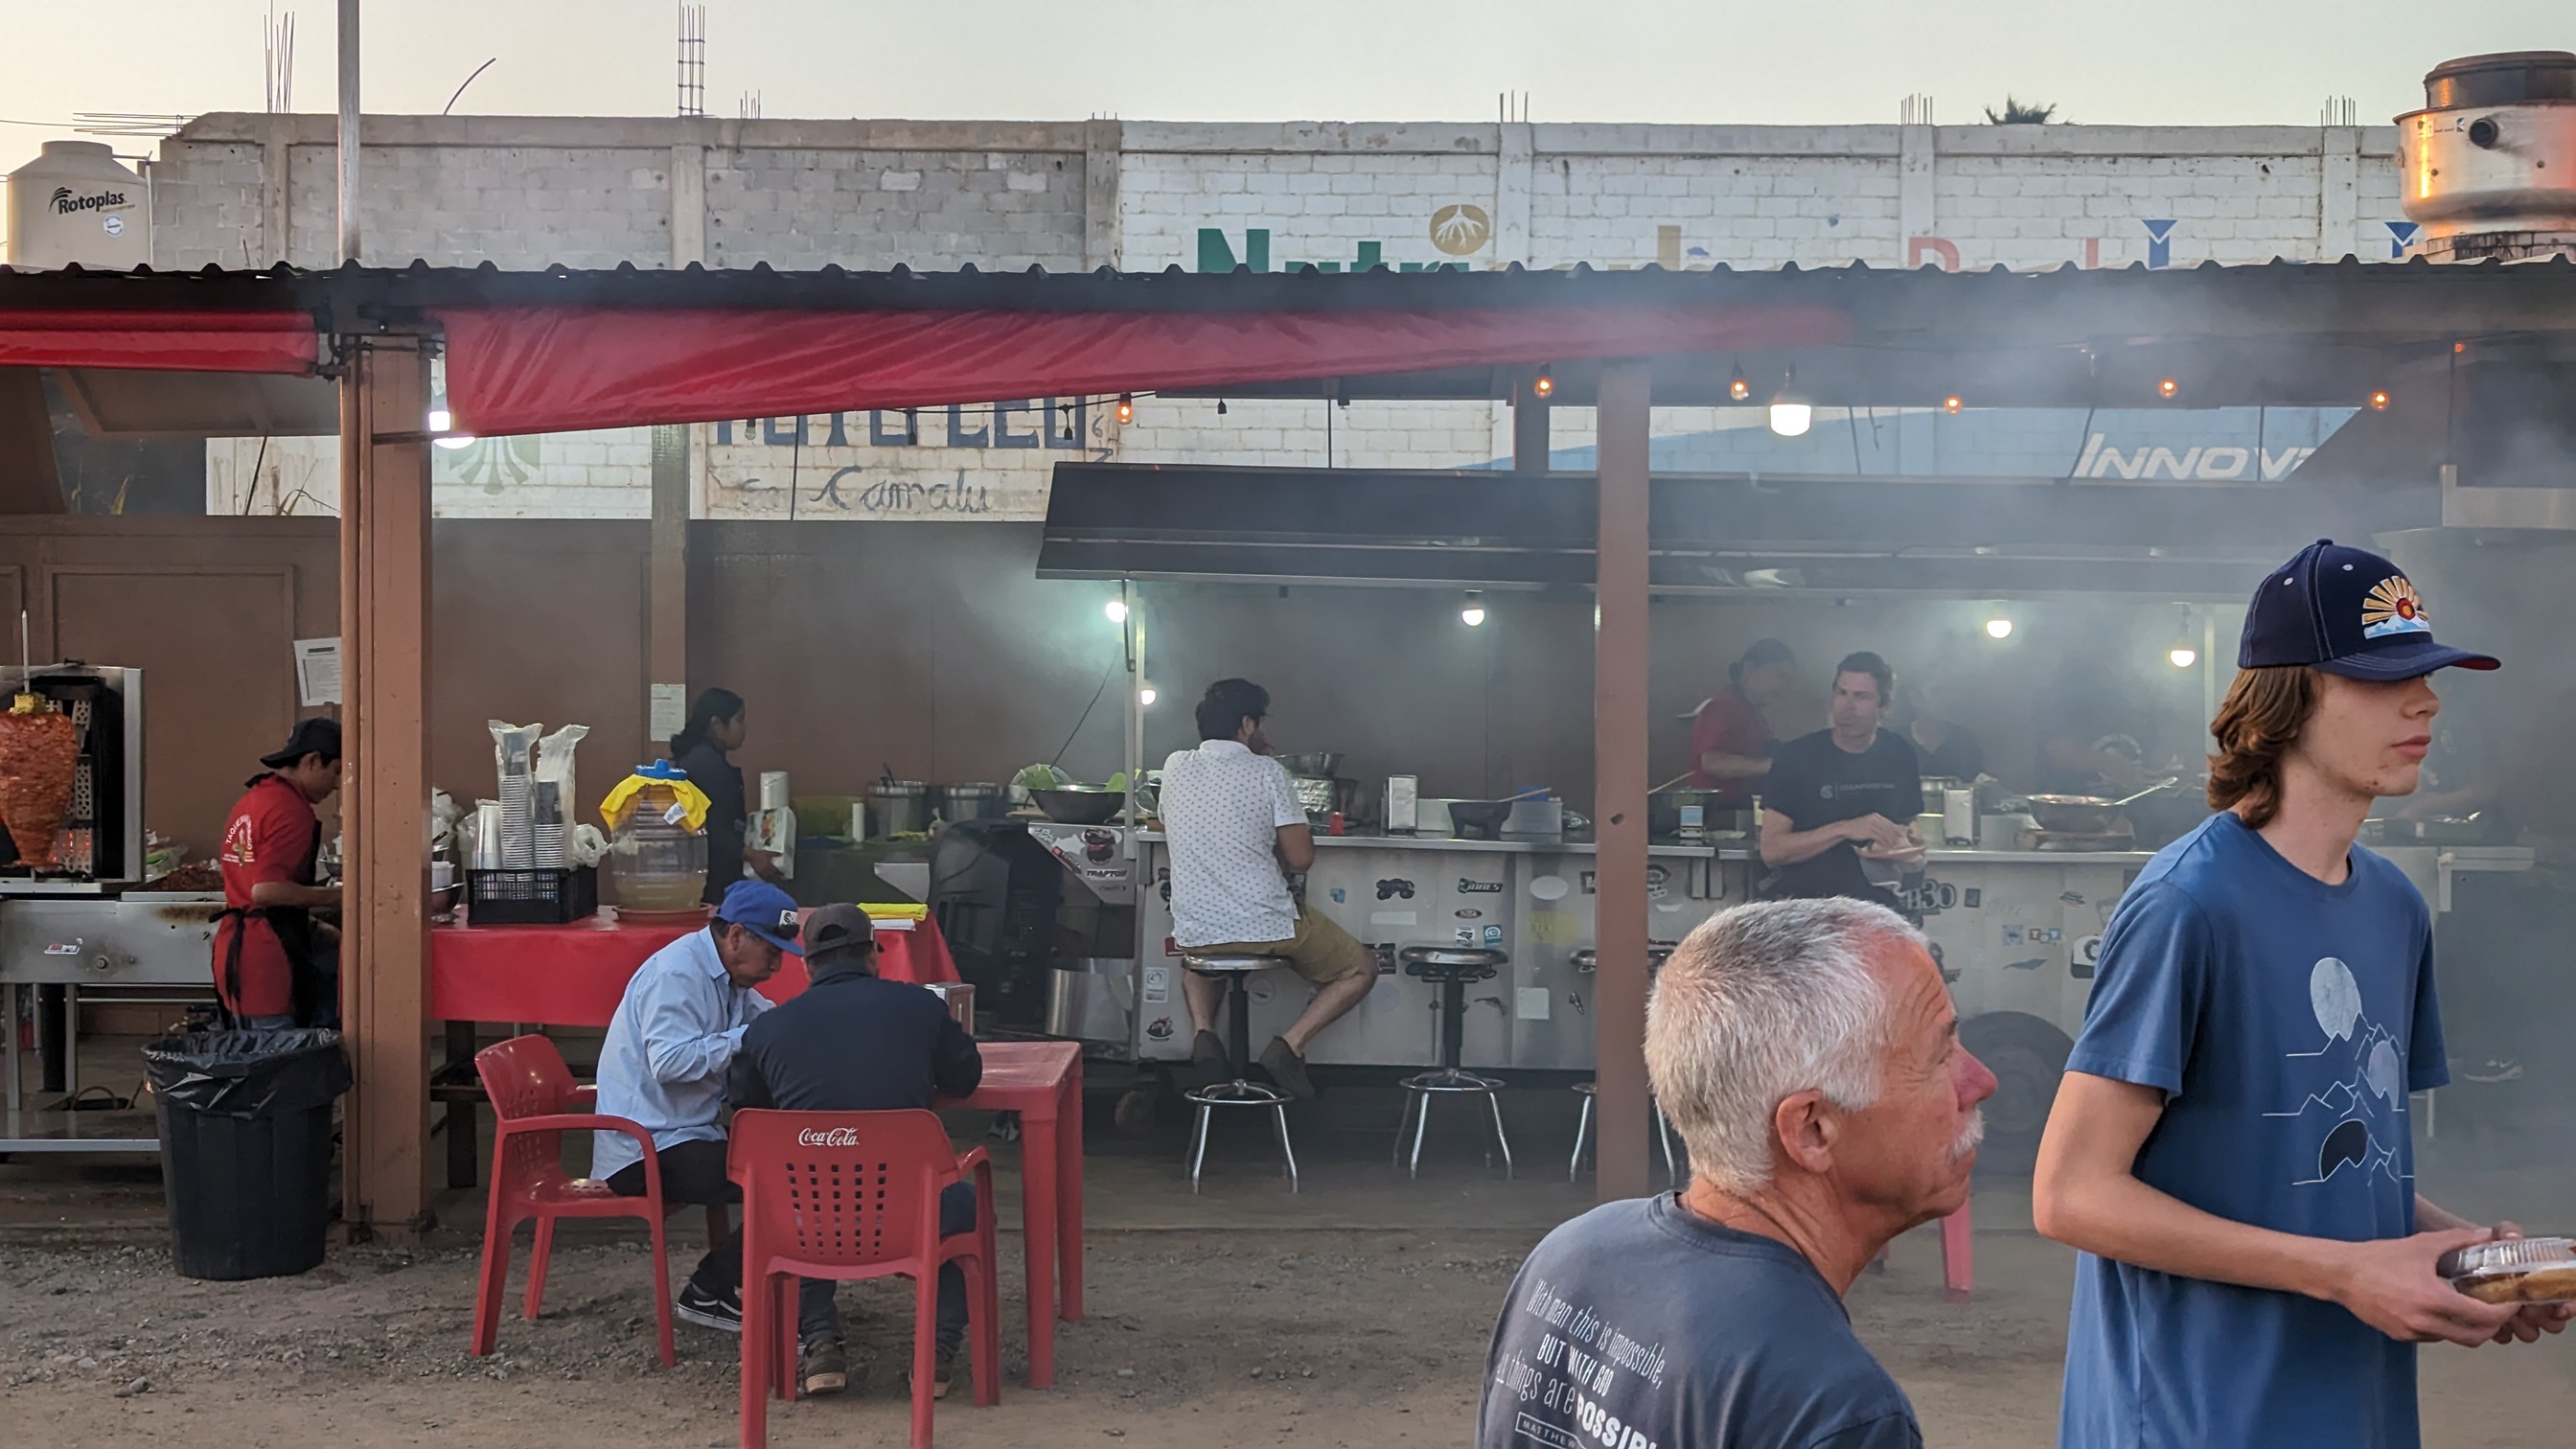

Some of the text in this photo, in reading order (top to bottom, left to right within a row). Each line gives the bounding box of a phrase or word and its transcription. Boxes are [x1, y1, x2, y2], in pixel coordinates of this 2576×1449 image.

[58, 190, 126, 215] Rotoplas
[798, 1127, 860, 1147] Coca-Cola
[1526, 1278, 1666, 1390] With man this is impossible,
[1536, 1333, 1615, 1398] BUT WITH GOD
[1506, 1348, 1543, 1402] things
[1543, 1377, 1576, 1414] are
[1576, 1392, 1658, 1449] POSSIB
[1522, 1419, 1577, 1448] MATTHEW
